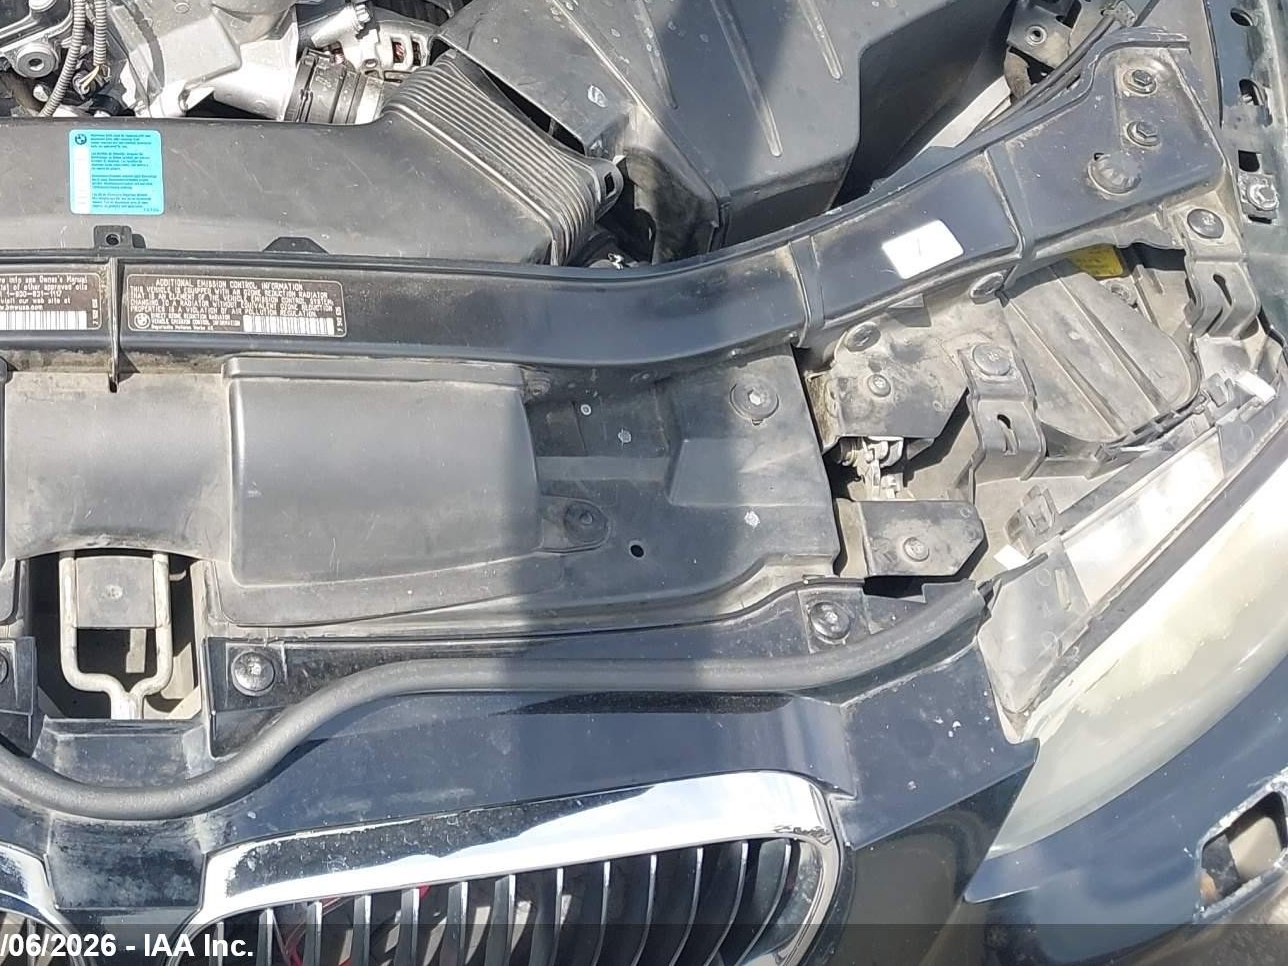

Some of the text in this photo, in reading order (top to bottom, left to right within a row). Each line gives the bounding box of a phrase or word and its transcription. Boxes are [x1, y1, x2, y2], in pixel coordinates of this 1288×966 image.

[155, 278, 303, 290] ADDITIONAL EMISSION CONTROL INFORMATION
[130, 285, 144, 293] THIS
[147, 286, 171, 294] VEHICLE
[183, 287, 211, 295] EQUIPPED
[299, 291, 328, 299] RADIATOR
